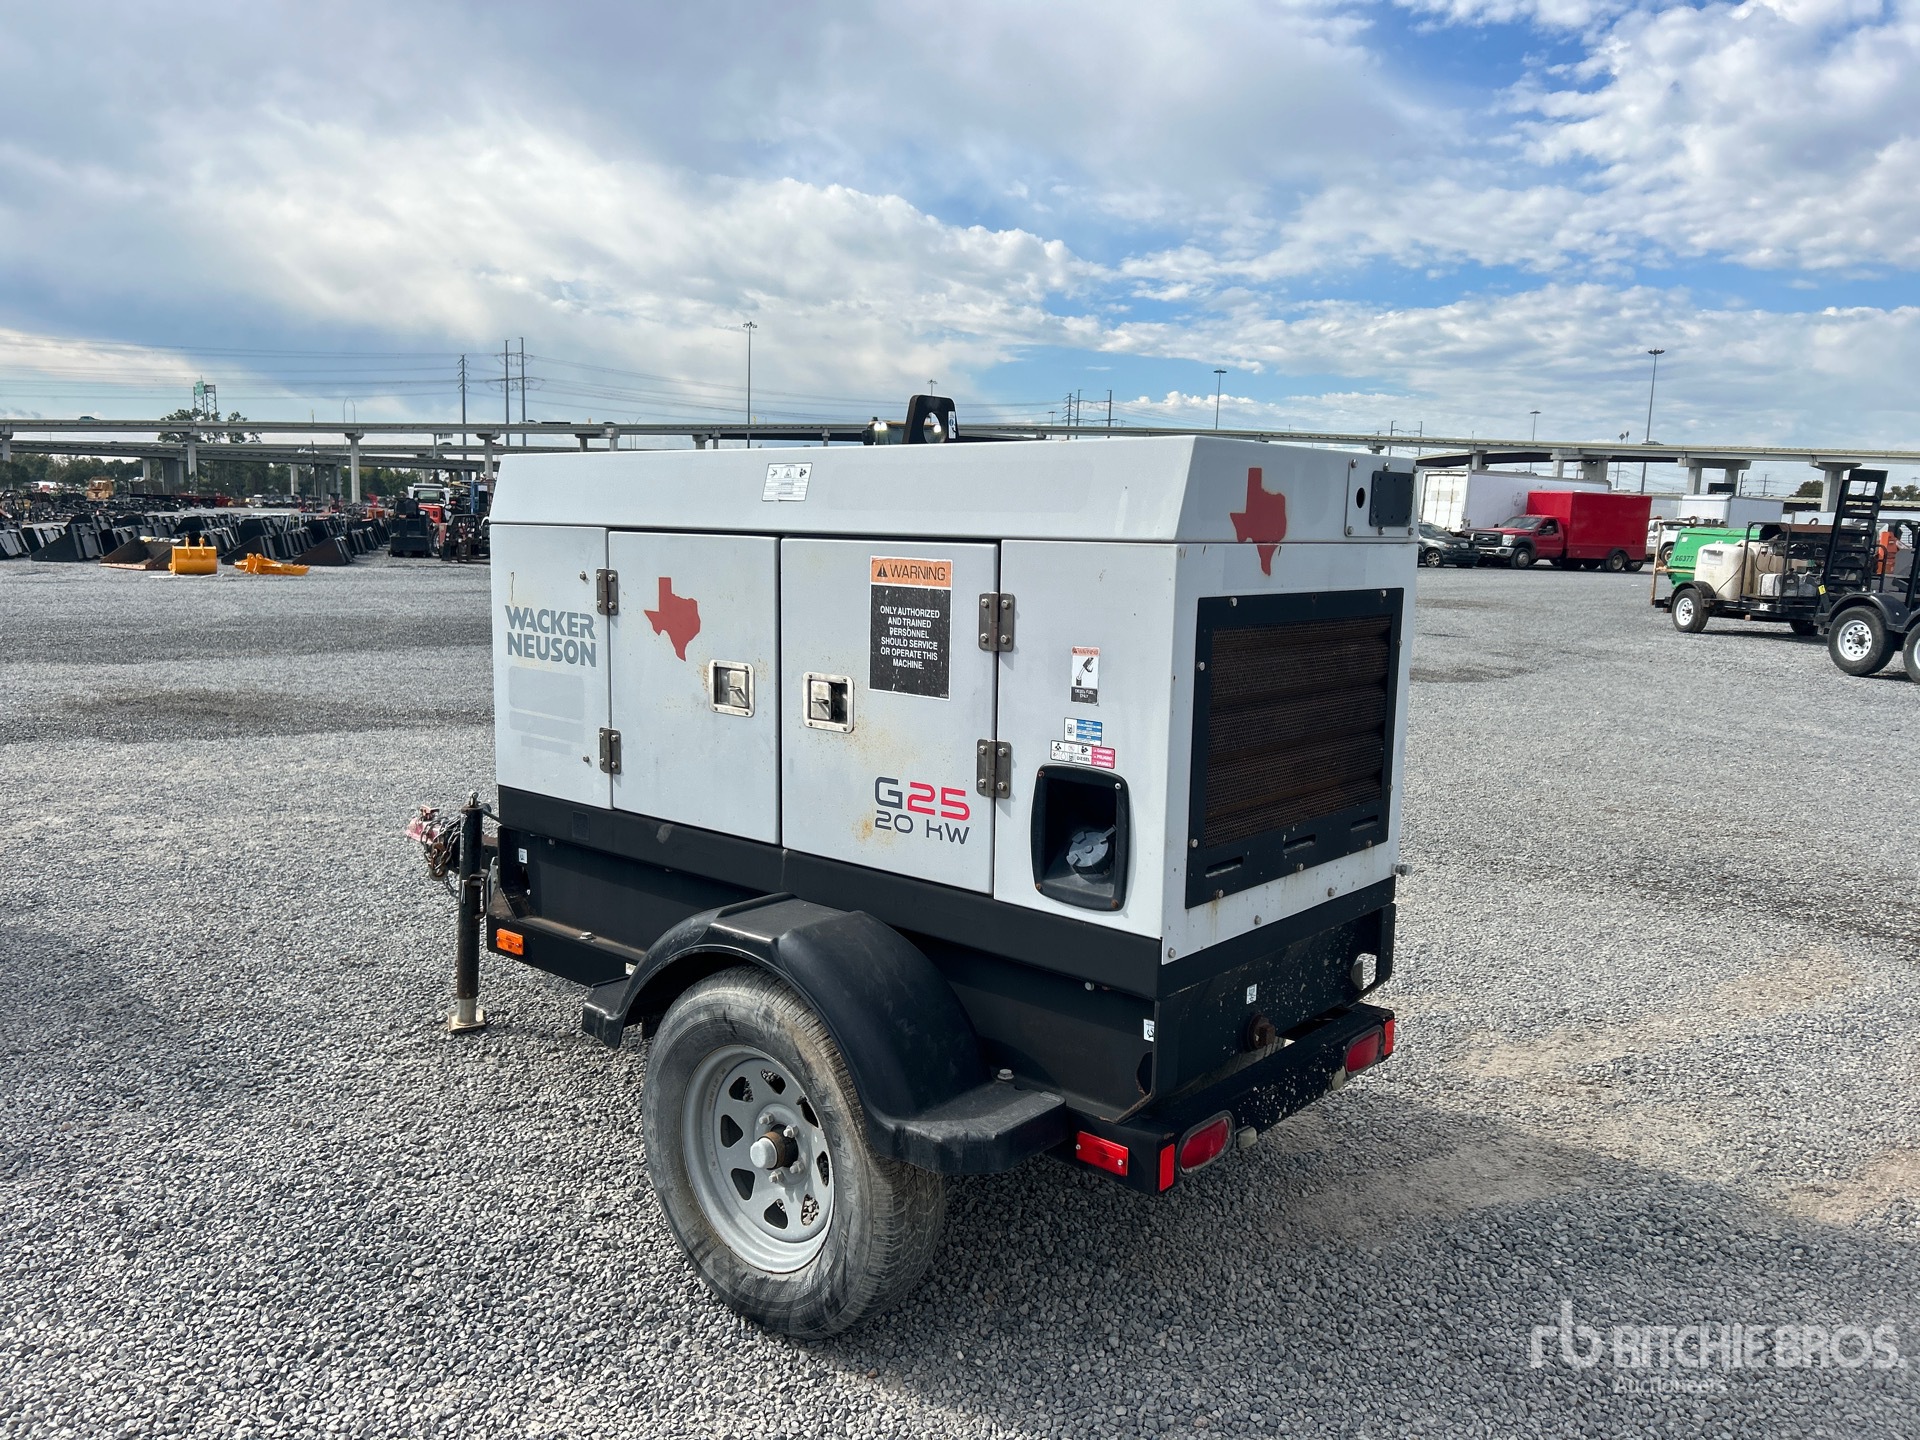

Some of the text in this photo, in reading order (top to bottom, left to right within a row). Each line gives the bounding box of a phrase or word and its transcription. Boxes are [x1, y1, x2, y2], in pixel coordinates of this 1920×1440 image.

[890, 564, 946, 581] WARNING
[880, 606, 940, 618] ONLY AUTHORIZED
[505, 605, 596, 639] WACKER
[888, 617, 931, 628] AND TRAINED
[890, 627, 929, 638] PERSONNEL
[508, 632, 596, 667] NEUSON
[881, 637, 937, 650] SHOULD SERVICE
[880, 647, 937, 660] OR OPERATE THIS
[893, 659, 924, 670] MACHINE.
[875, 777, 970, 821] G25
[875, 810, 913, 833] 20
